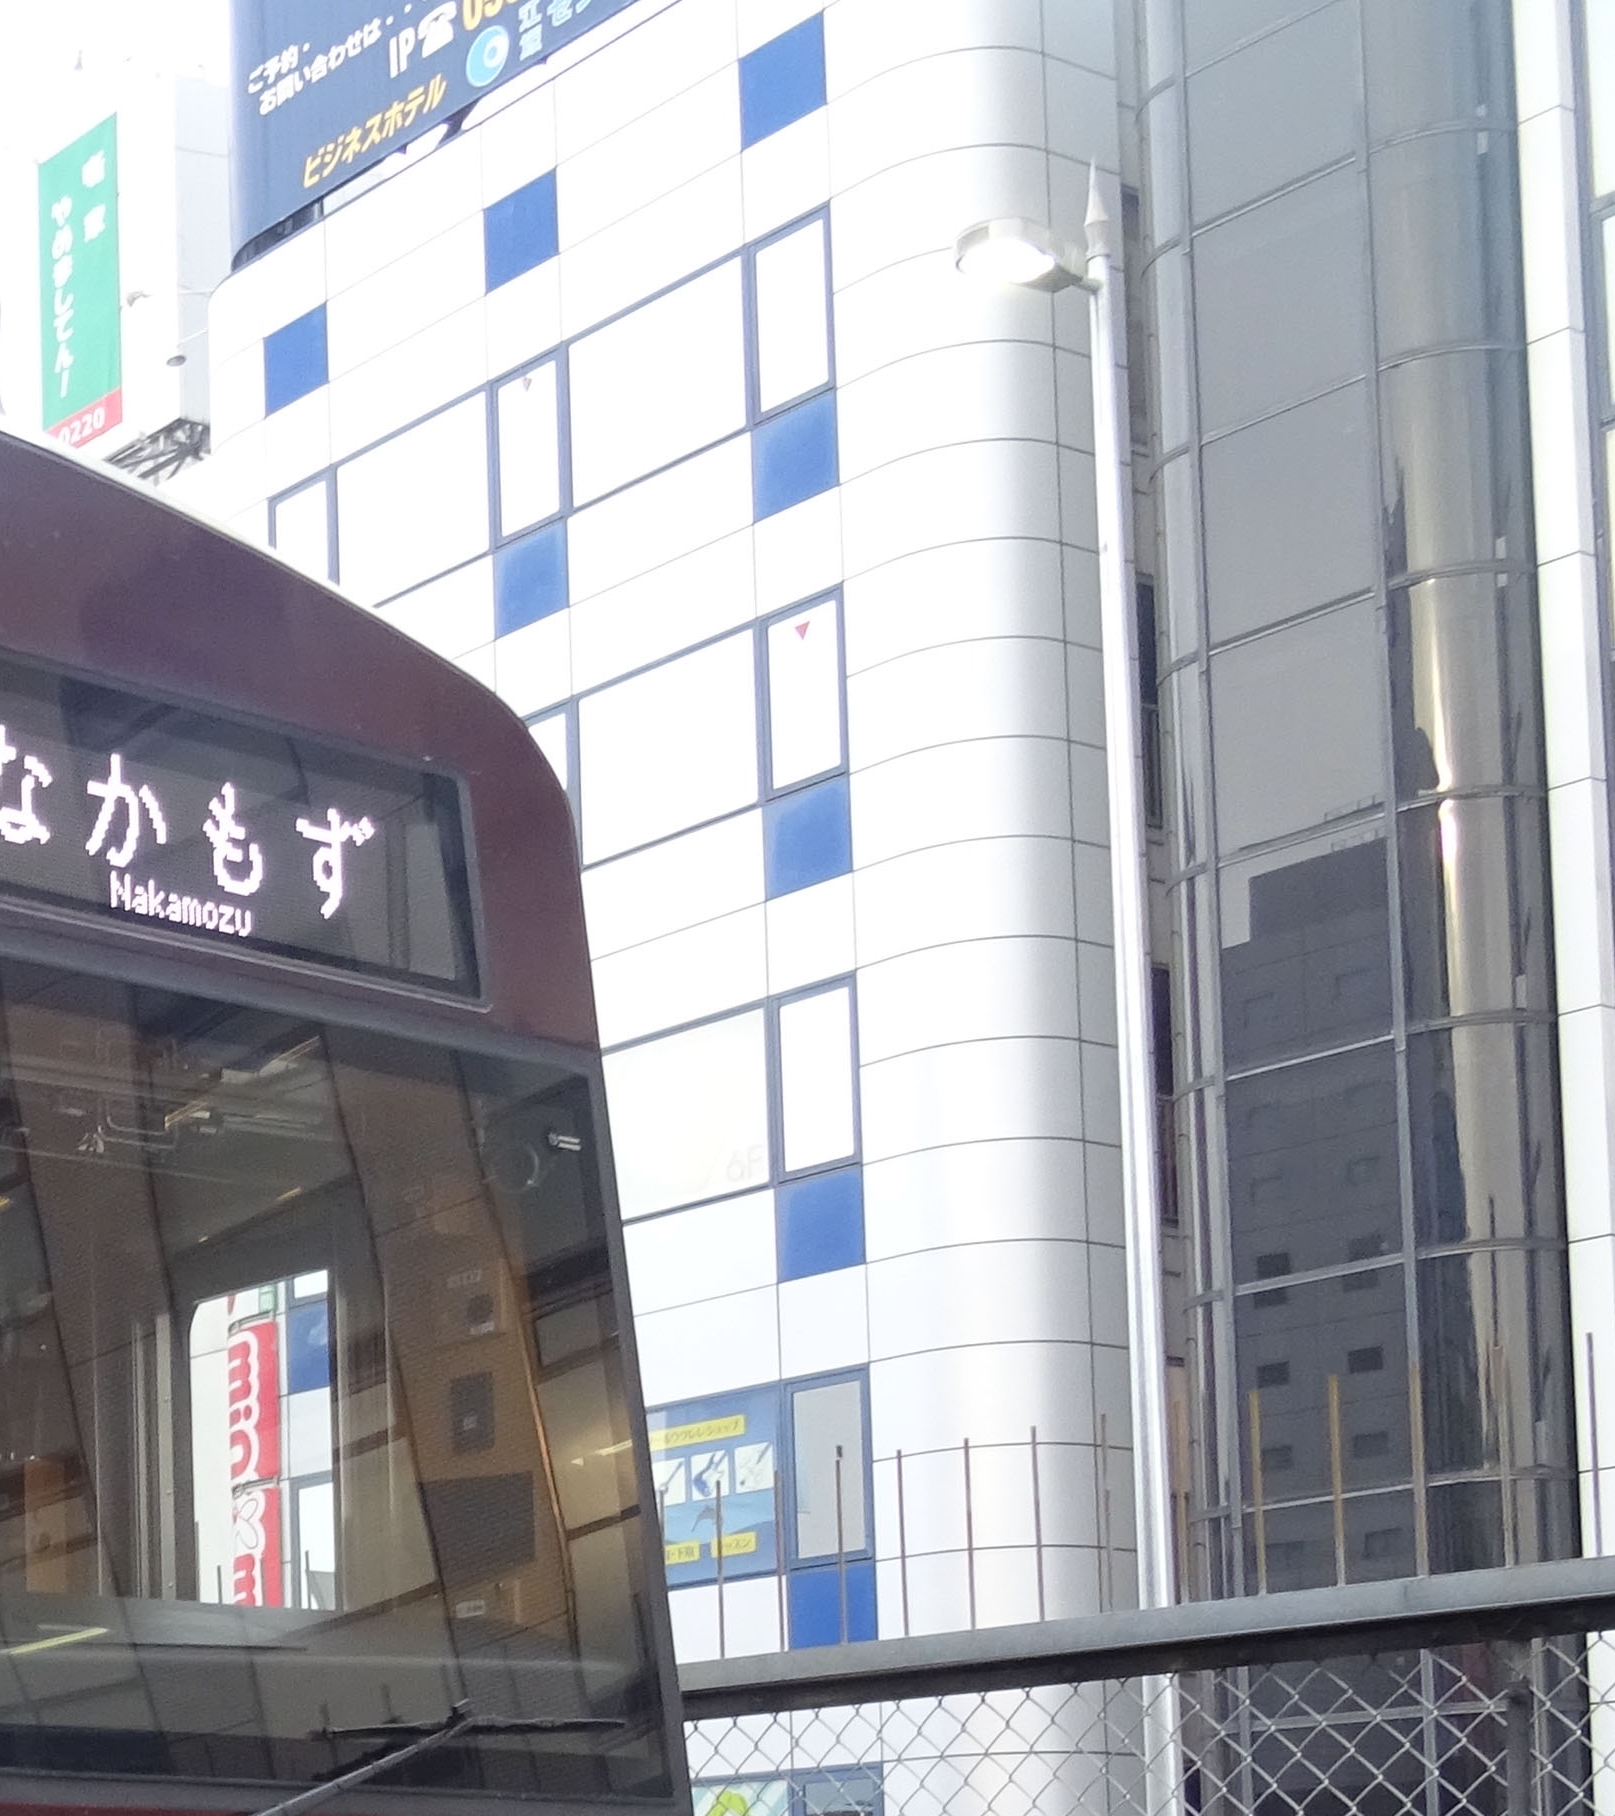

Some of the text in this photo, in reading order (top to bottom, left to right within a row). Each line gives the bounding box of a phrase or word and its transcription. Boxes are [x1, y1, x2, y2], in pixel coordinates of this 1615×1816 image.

[388, 25, 416, 79] IP
[302, 73, 448, 189] ビジネスホテル
[109, 869, 253, 938] Nakamozu
